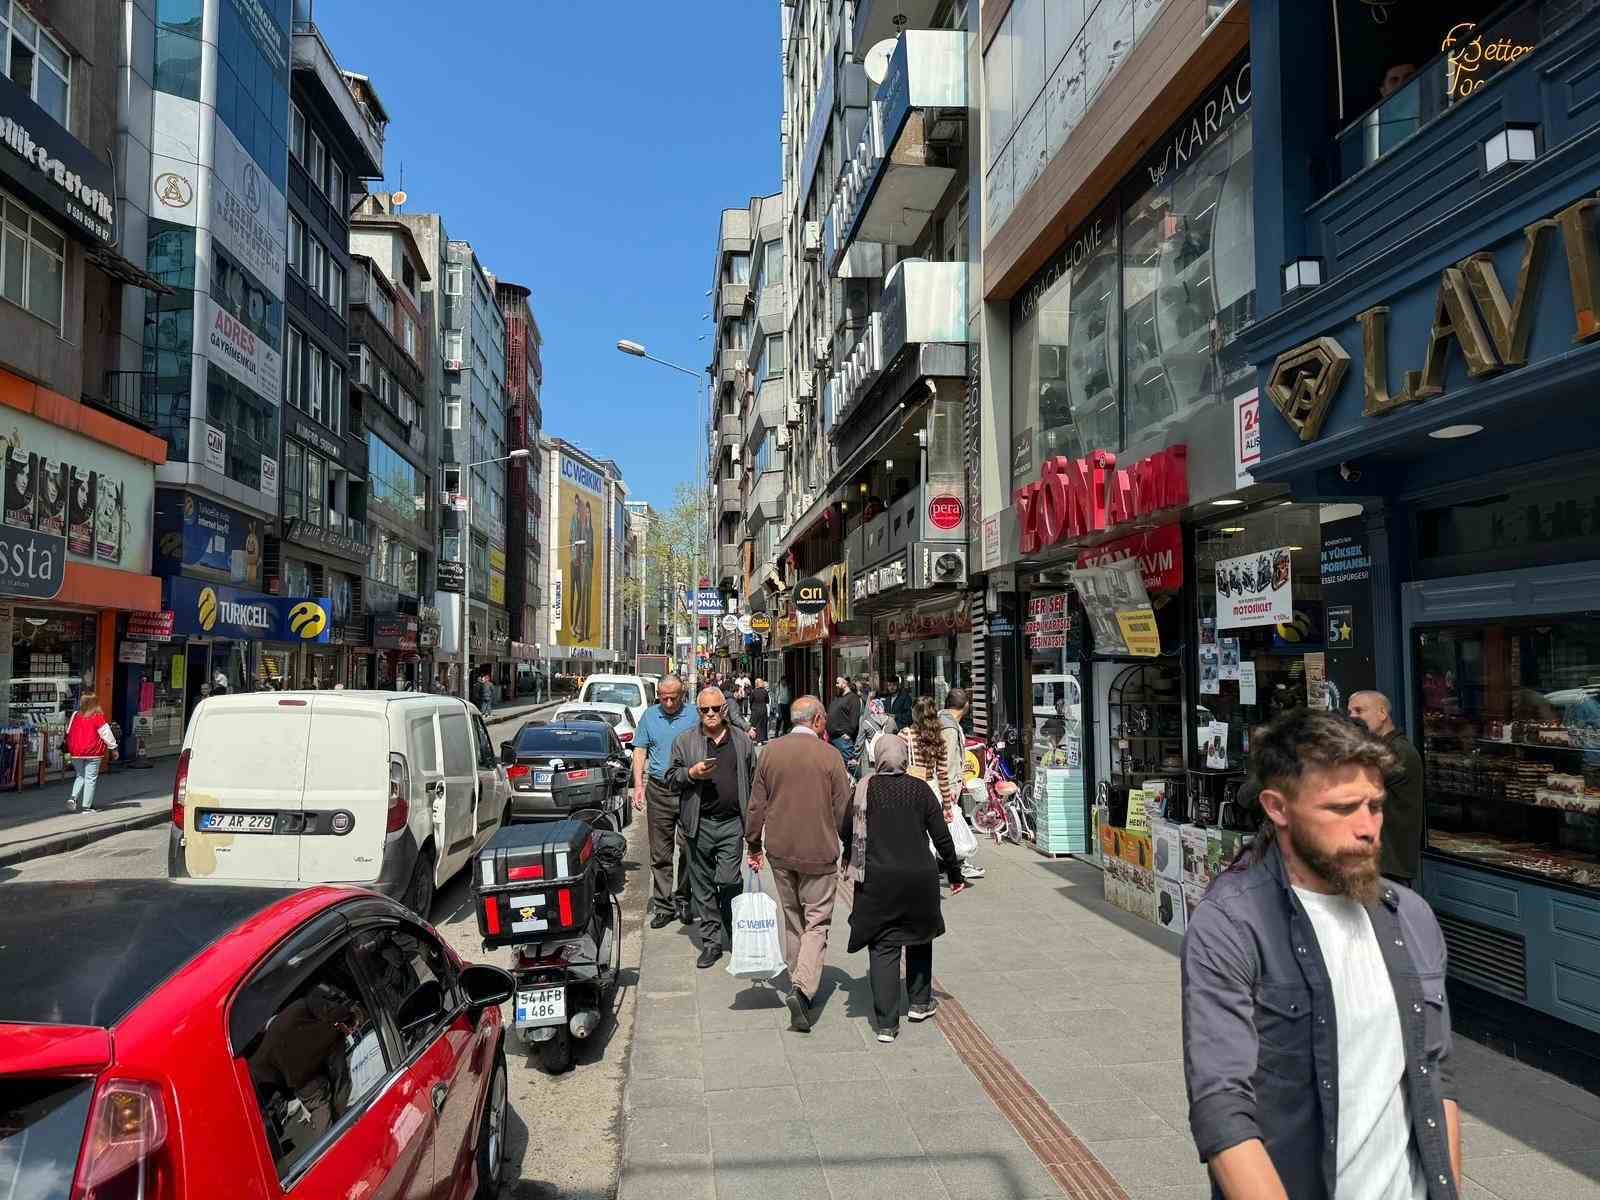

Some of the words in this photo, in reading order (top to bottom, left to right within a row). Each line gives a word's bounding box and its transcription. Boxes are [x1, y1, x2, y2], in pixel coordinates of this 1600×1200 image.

[1065, 220, 1102, 270] HOME
[215, 309, 257, 356] ADRES
[932, 502, 960, 514] pera
[219, 600, 270, 628] TURKCELL
[1329, 619, 1340, 641] 5
[209, 815, 223, 827] 67
[228, 816, 244, 828] AR
[249, 816, 272, 828] 279
[520, 993, 537, 1005] 54
[539, 989, 562, 1003] AFB
[531, 1004, 555, 1017] 486
